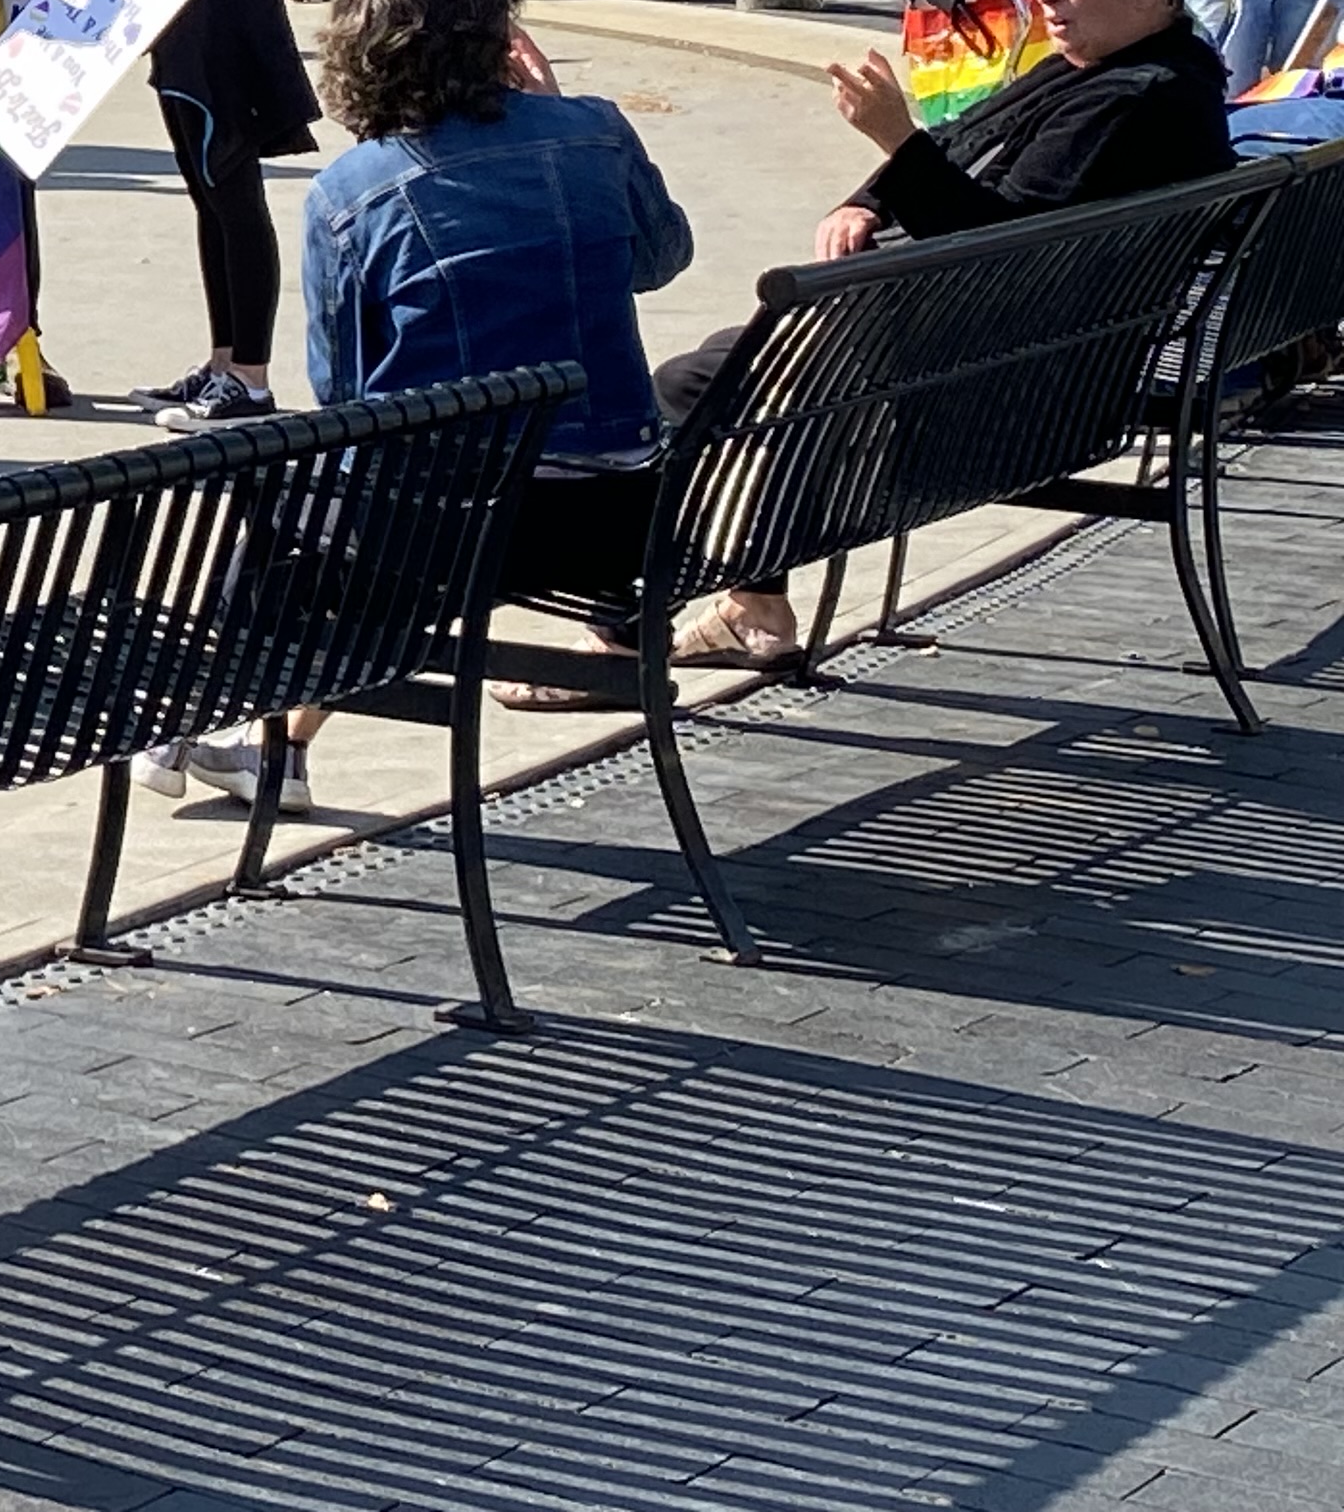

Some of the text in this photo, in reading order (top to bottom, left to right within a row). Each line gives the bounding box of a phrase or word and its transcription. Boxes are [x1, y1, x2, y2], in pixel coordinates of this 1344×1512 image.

[80, 15, 97, 34] &
[61, 54, 86, 87] You
[6, 91, 28, 123] To
[19, 105, 62, 148] Free
